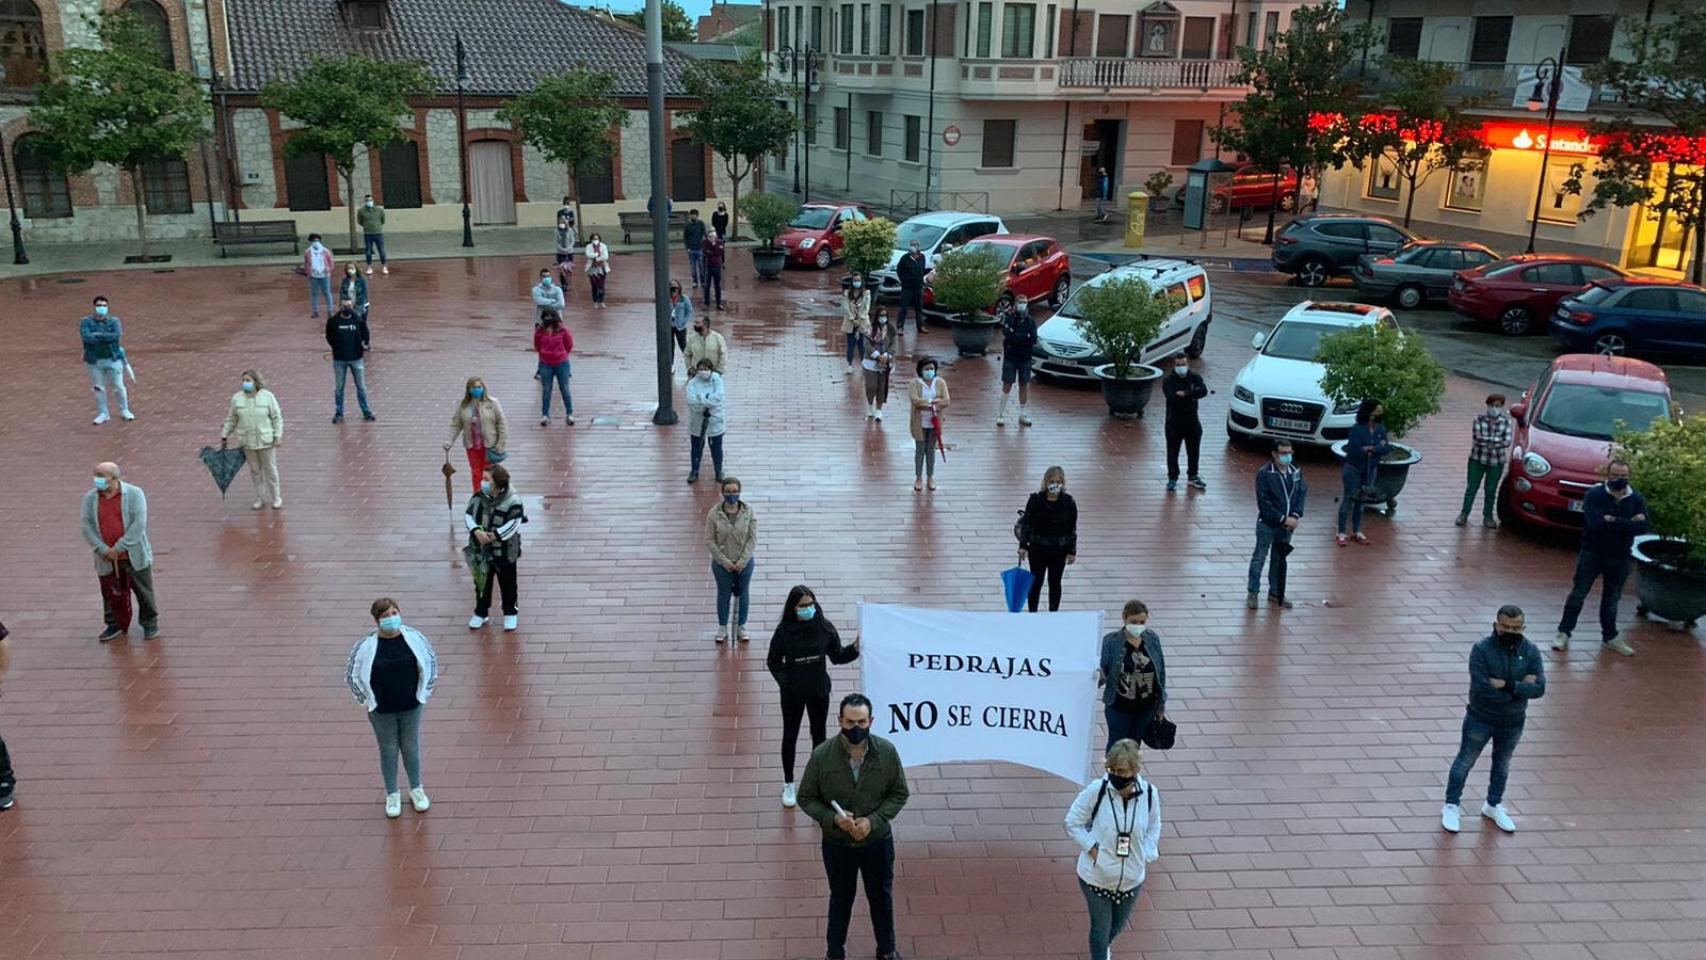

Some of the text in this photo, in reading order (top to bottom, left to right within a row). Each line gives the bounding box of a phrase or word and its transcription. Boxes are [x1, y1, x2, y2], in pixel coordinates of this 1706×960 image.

[908, 653, 1052, 679] PEDRAJAS
[888, 701, 1069, 737] NO SE CIERRA
